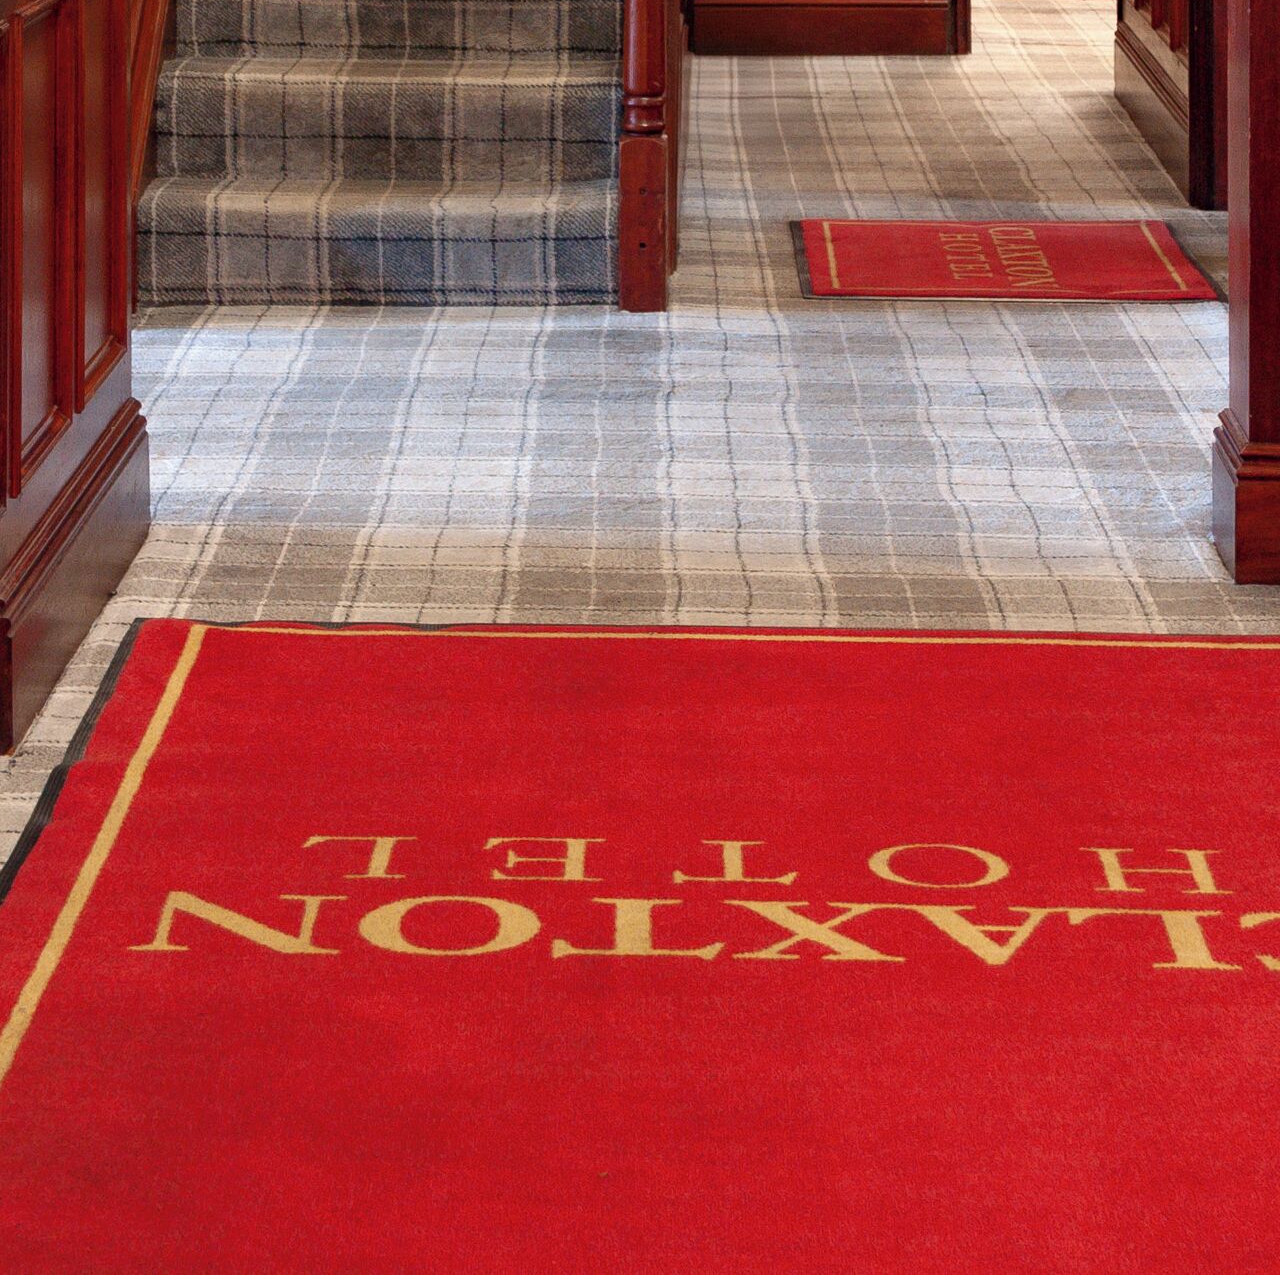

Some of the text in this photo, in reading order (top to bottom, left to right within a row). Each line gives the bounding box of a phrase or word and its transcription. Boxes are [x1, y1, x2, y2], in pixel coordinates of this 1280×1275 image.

[938, 232, 993, 280] HOTEL
[987, 226, 1060, 288] CLAXTON
[302, 834, 1235, 895] HOTEL
